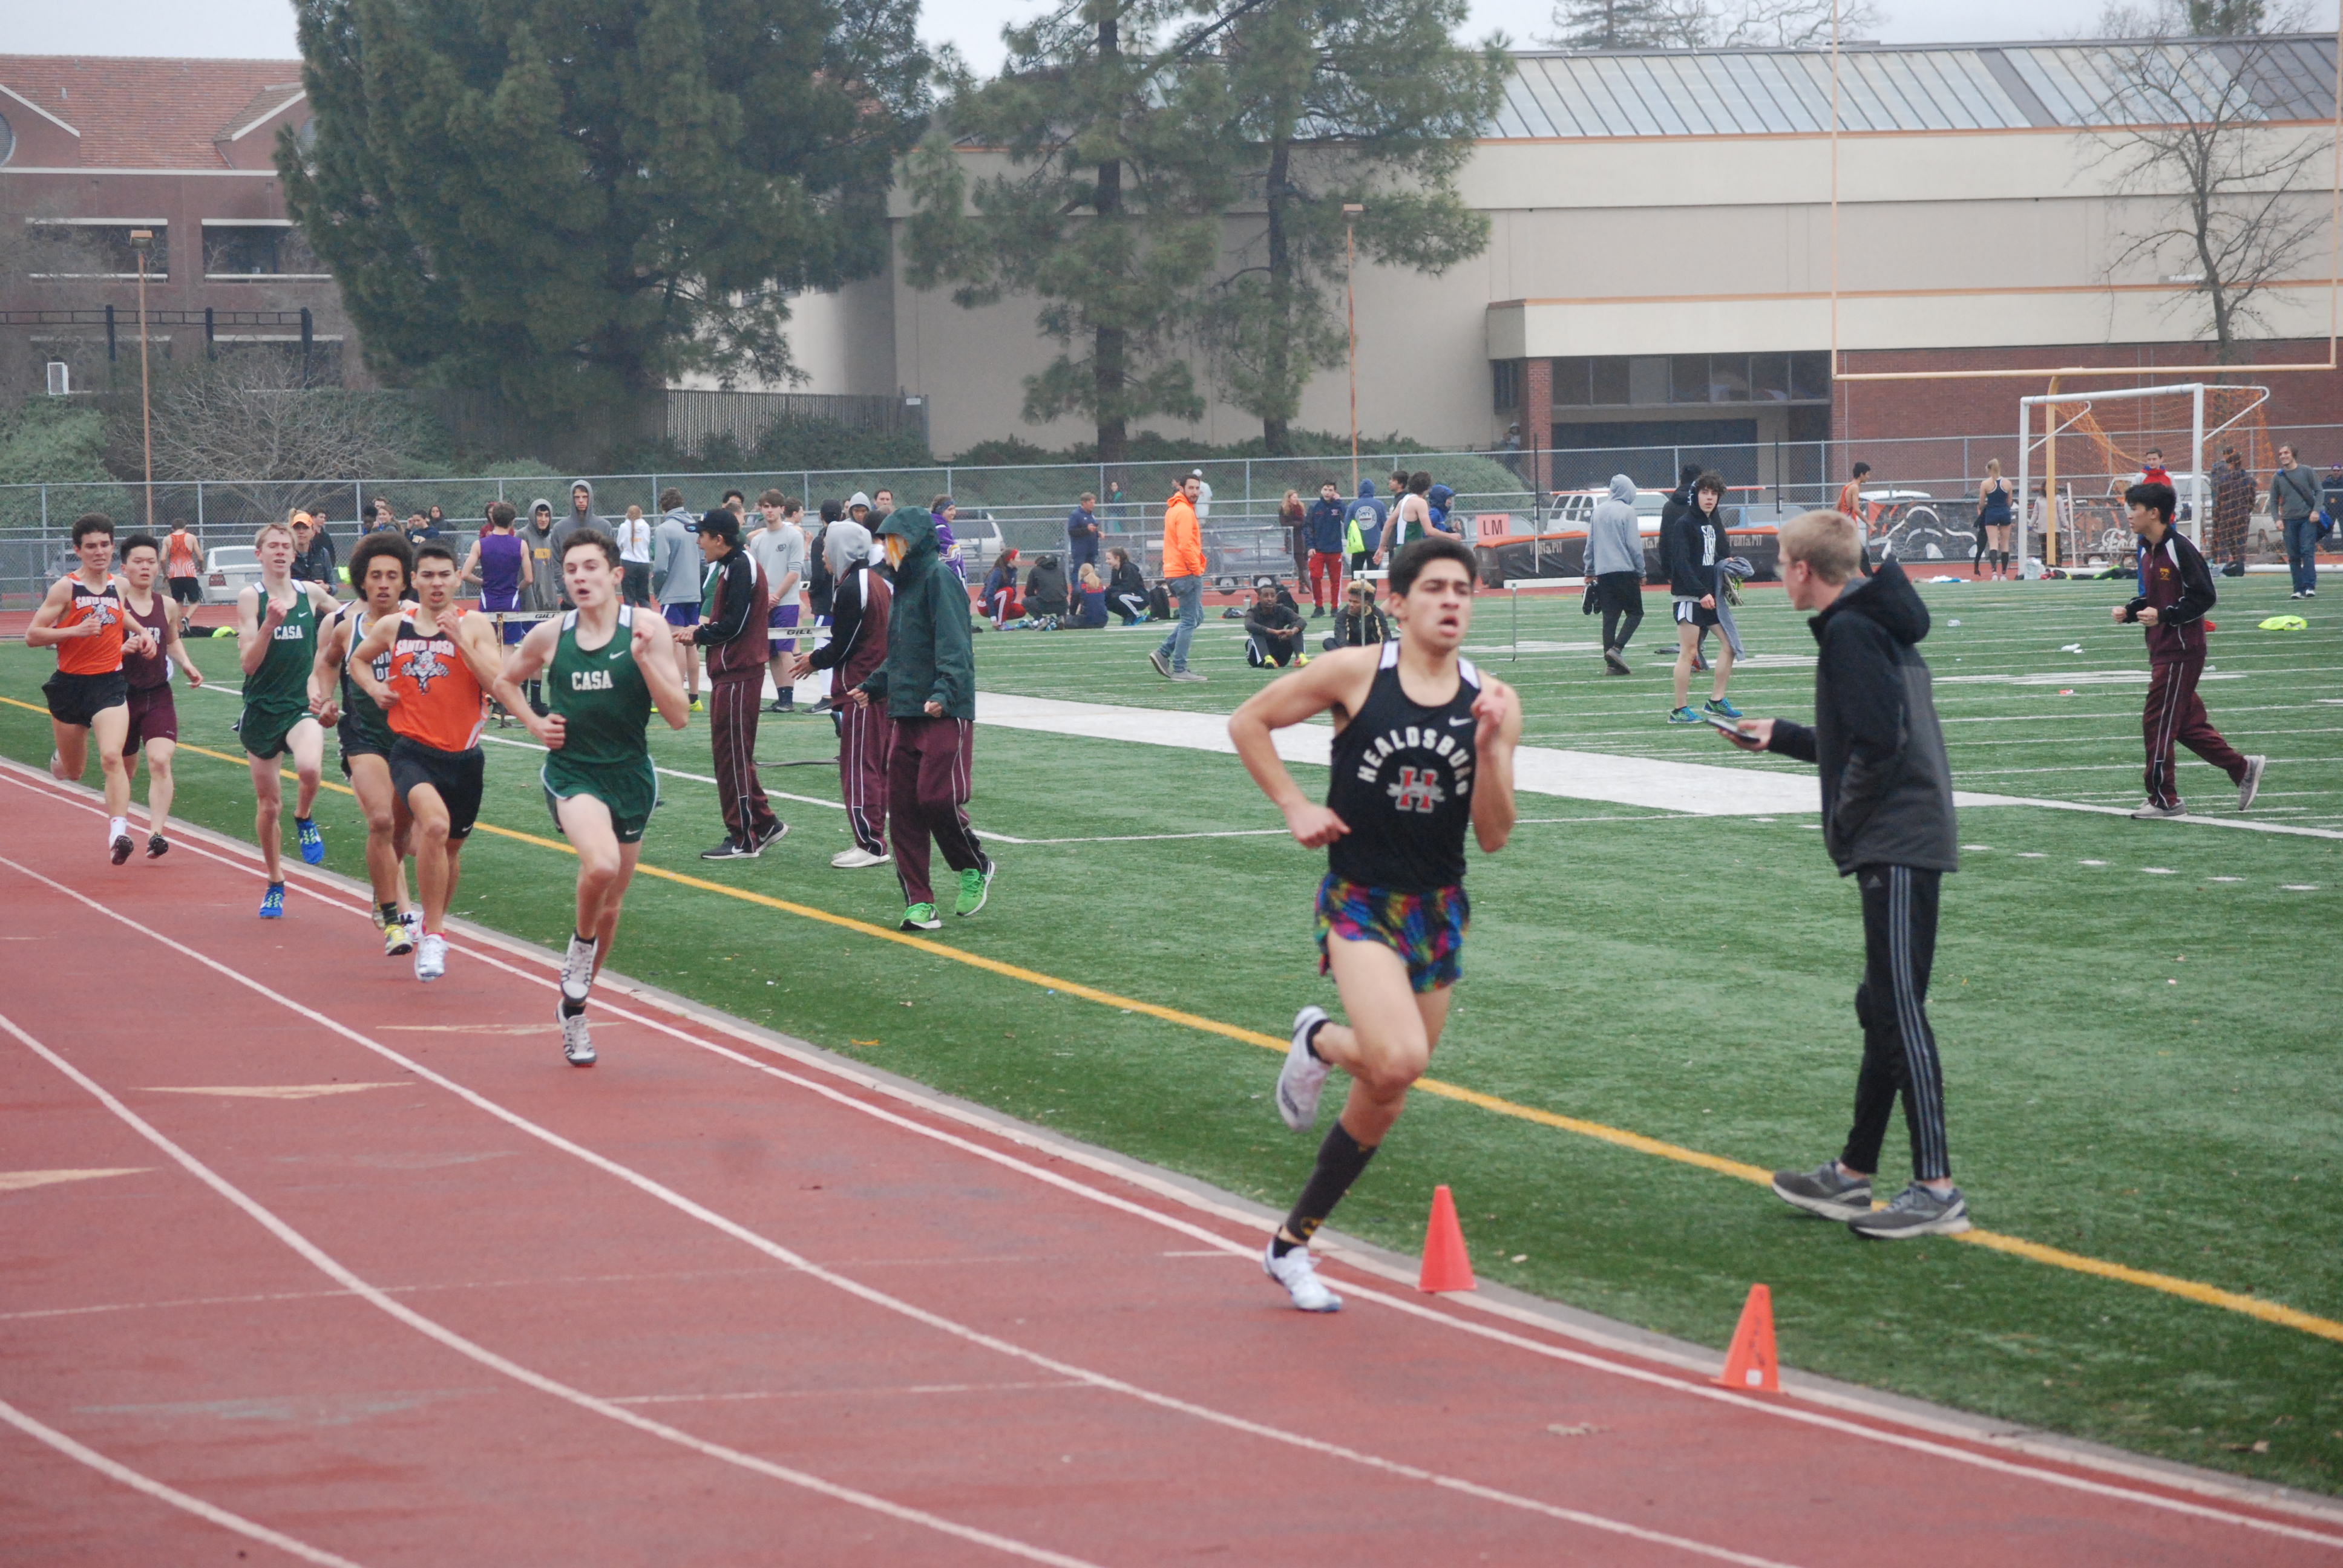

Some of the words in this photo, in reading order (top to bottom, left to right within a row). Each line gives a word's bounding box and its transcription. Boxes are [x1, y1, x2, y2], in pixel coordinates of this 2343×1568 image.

[1483, 519, 1503, 536] LM
[75, 596, 100, 610] SANTA
[100, 597, 119, 611] ROSA
[274, 624, 303, 640] CASA
[395, 639, 427, 657] SANTA
[428, 639, 456, 658] ROSA
[571, 670, 614, 691] CASA
